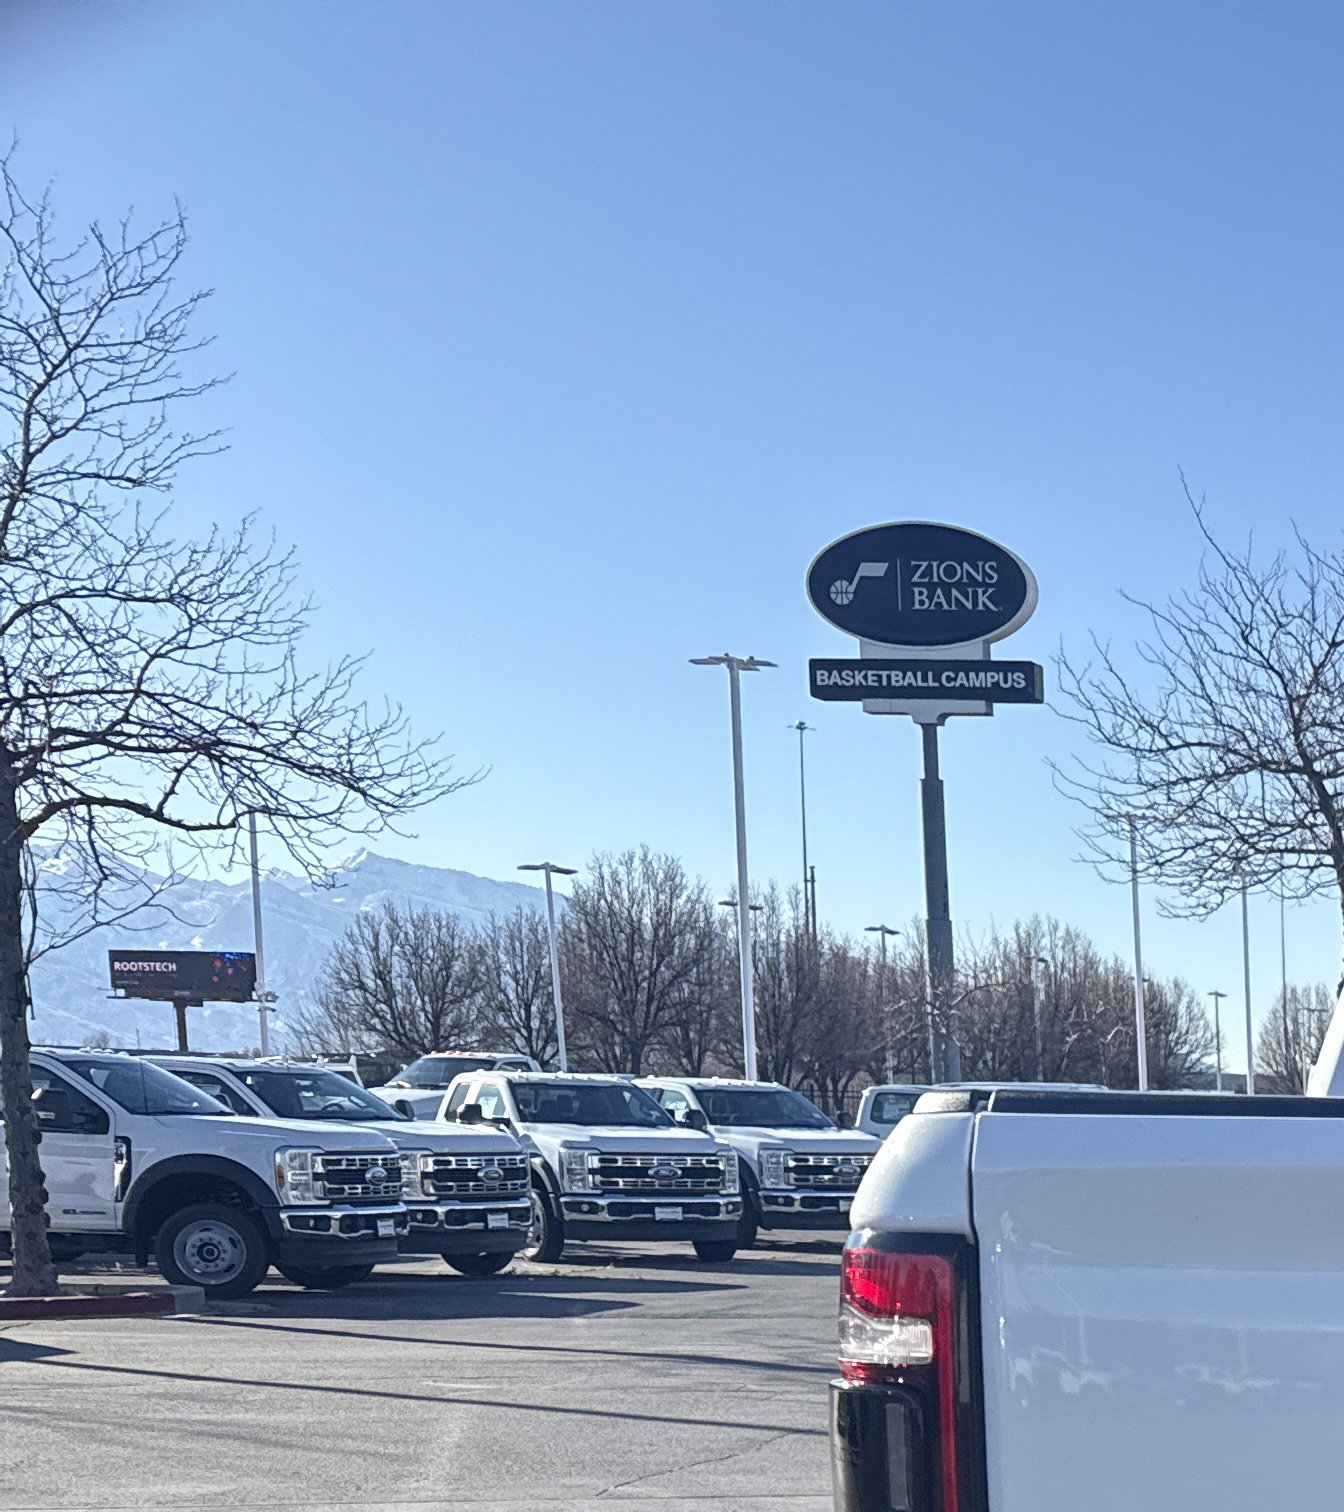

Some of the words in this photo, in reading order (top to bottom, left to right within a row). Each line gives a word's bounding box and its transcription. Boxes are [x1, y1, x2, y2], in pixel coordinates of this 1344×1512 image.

[910, 561, 998, 584] ZIONS
[912, 587, 999, 612] BANK
[815, 669, 940, 687] BASKETBALL
[941, 670, 1026, 689] CAMPUS
[113, 961, 177, 972] ROOTSTECH
